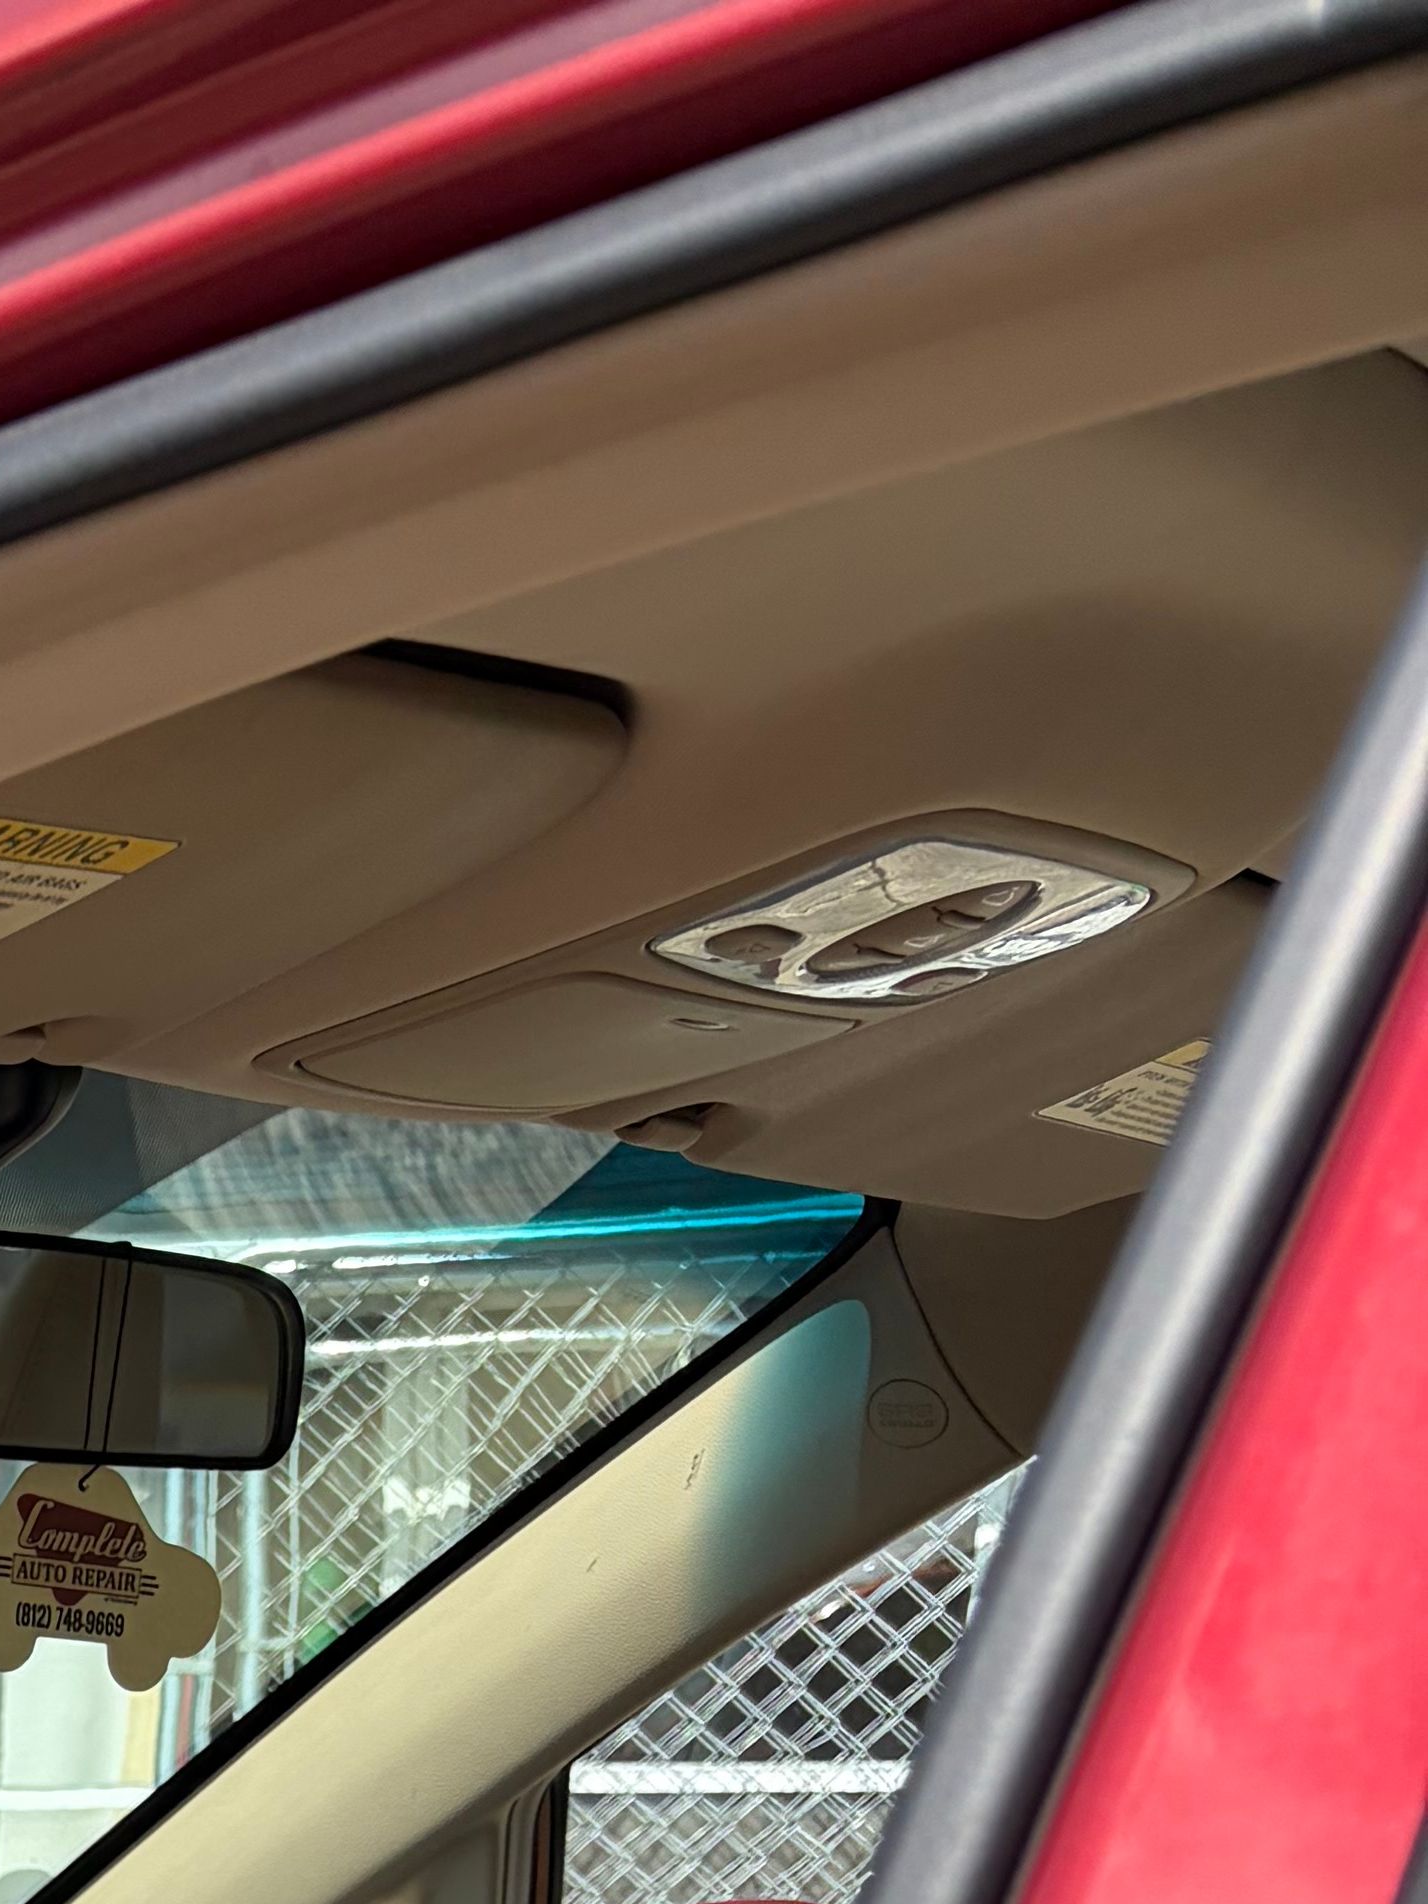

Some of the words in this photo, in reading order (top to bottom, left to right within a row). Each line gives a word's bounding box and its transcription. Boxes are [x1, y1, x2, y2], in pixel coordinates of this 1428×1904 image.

[17, 1498, 148, 1562] Complete
[16, 1559, 67, 1584] AUTO
[72, 1565, 137, 1593] REPAIR
[15, 1601, 52, 1630] (812)
[54, 1606, 126, 1637] 748-9669
